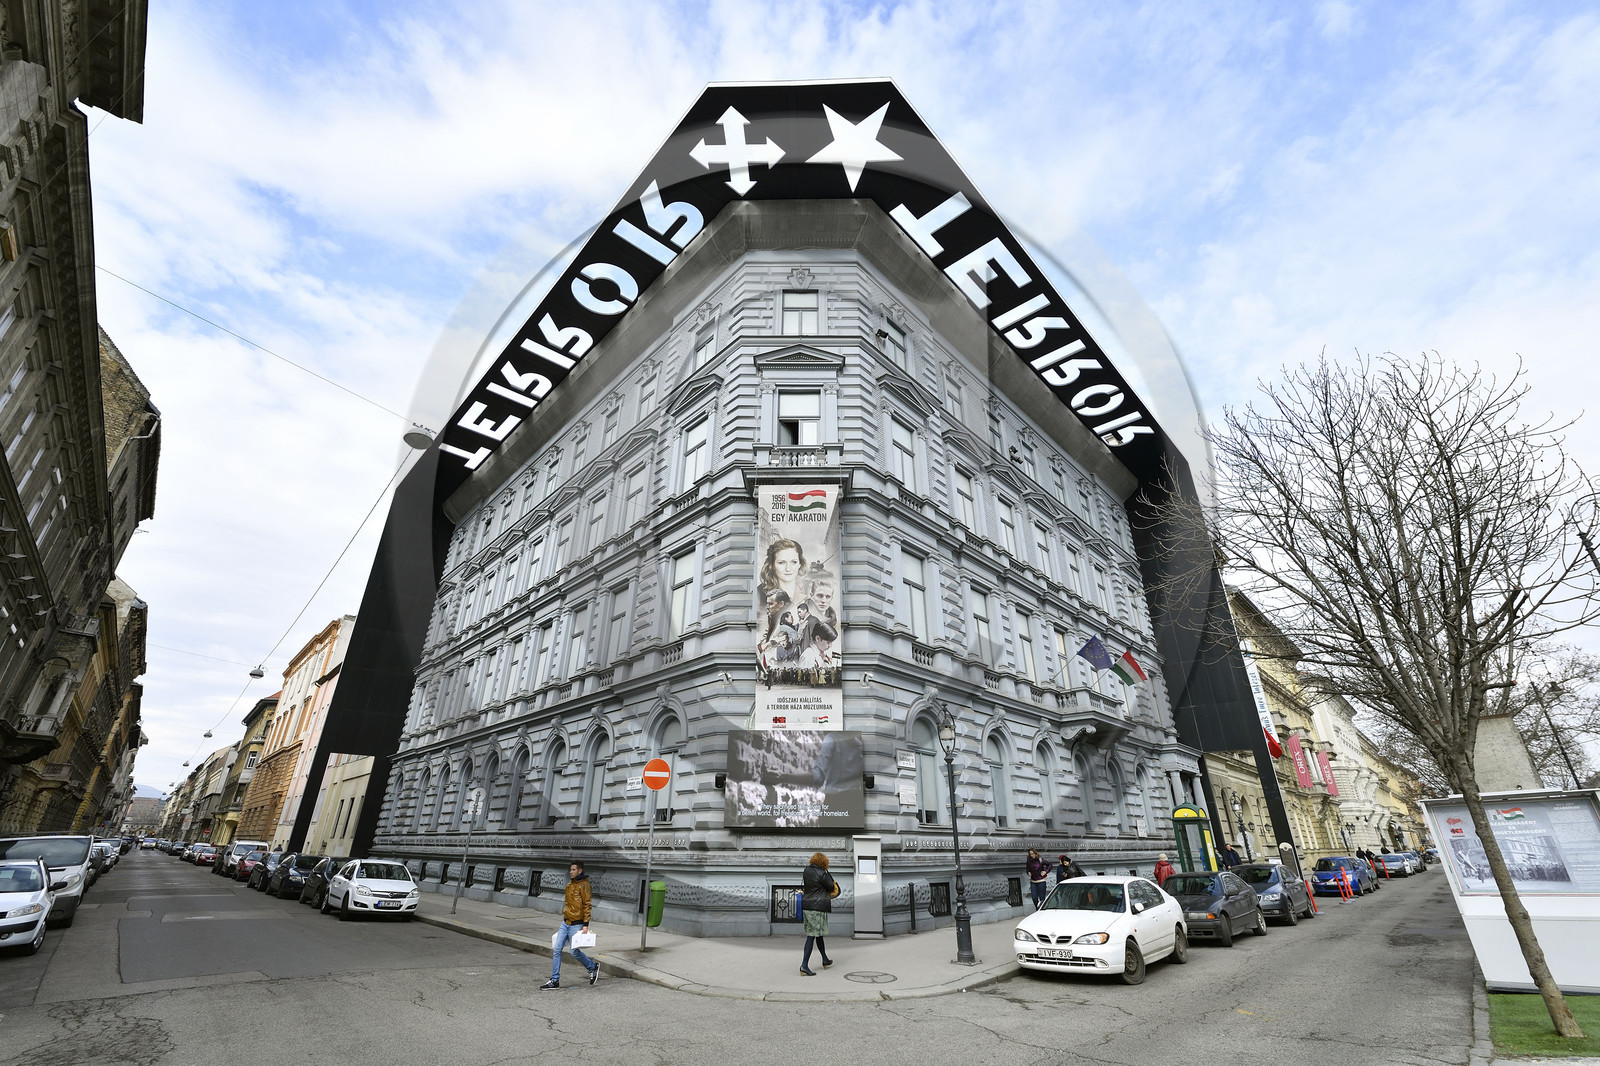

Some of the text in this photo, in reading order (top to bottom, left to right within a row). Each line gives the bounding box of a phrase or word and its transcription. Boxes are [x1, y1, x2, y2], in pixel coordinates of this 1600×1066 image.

[772, 513, 827, 522] EGY AKARATON
[1294, 751, 1306, 774] OREX
[1323, 764, 1334, 785] OREX
[1044, 950, 1071, 958] IVF-930
